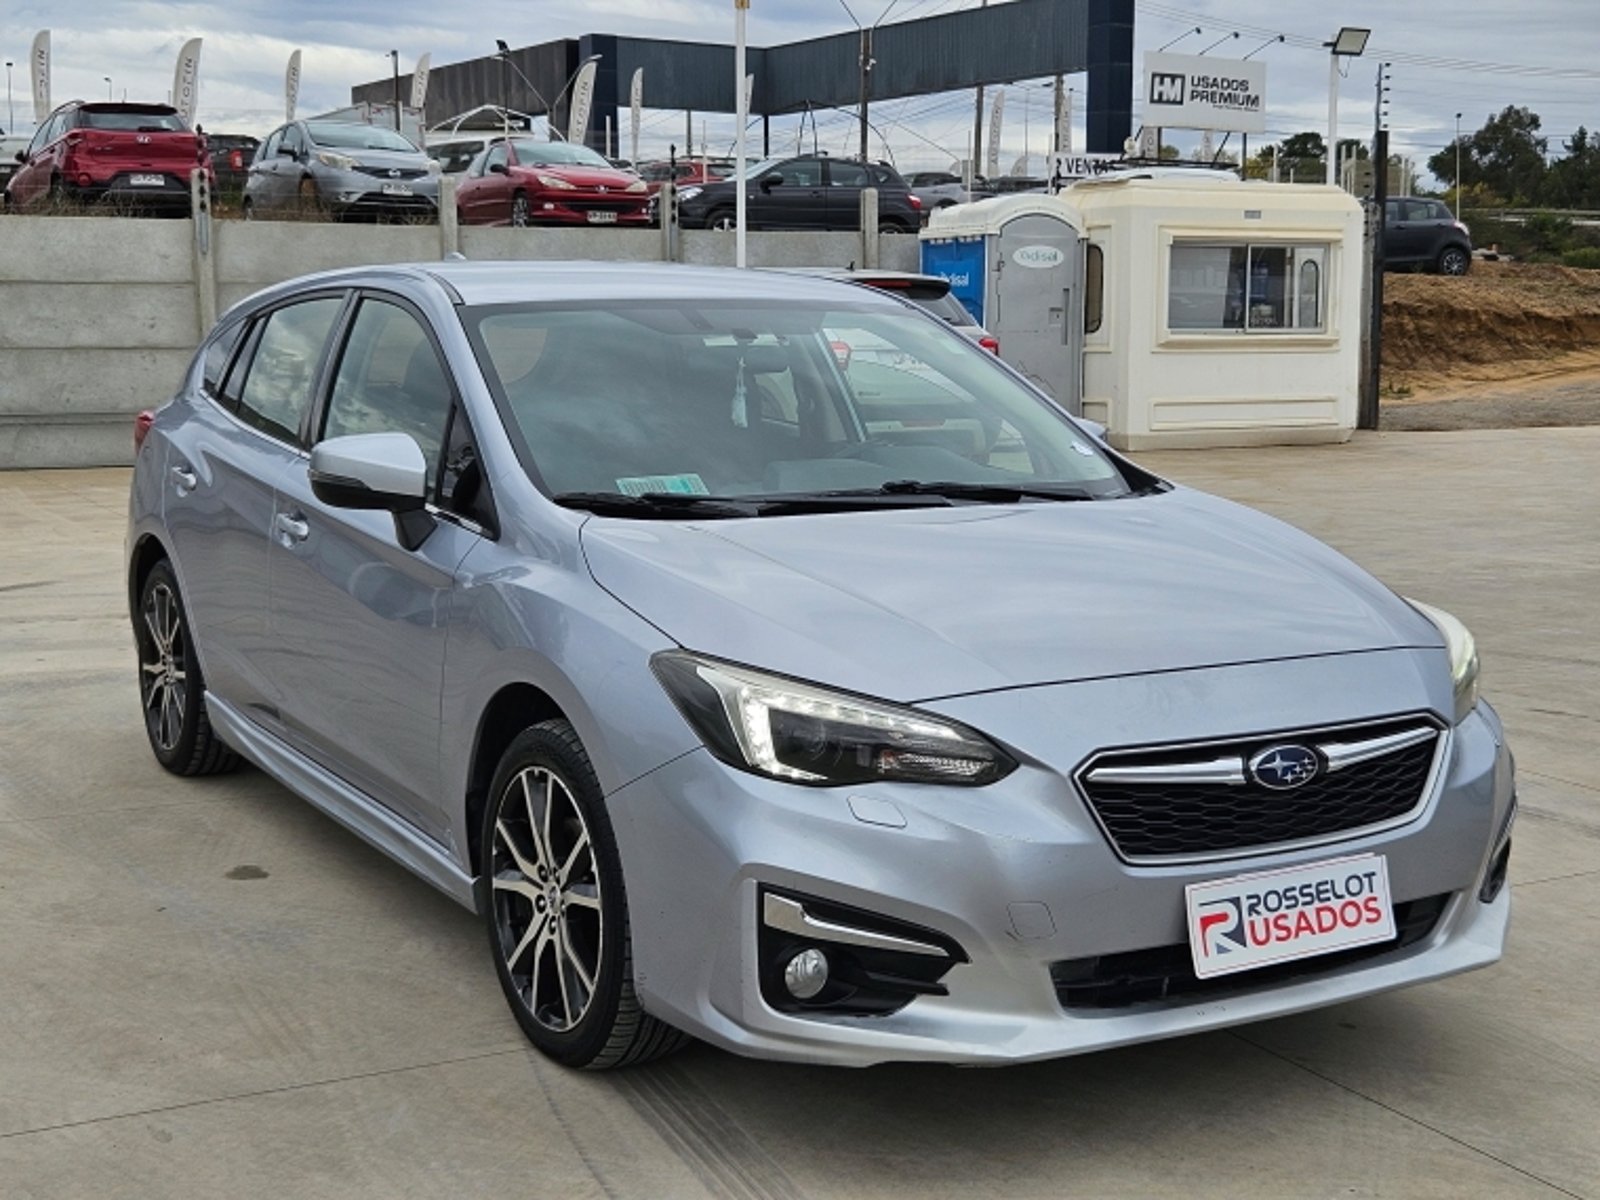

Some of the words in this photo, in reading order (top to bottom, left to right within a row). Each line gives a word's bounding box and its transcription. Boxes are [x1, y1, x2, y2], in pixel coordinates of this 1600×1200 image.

[180, 56, 193, 119] UTOFIN
[1151, 74, 1183, 103] HM
[1190, 89, 1260, 108] PREMIUM
[1191, 75, 1249, 92] USADOS
[1246, 871, 1377, 917] ROSSELOT
[1249, 896, 1382, 946] USADOS
